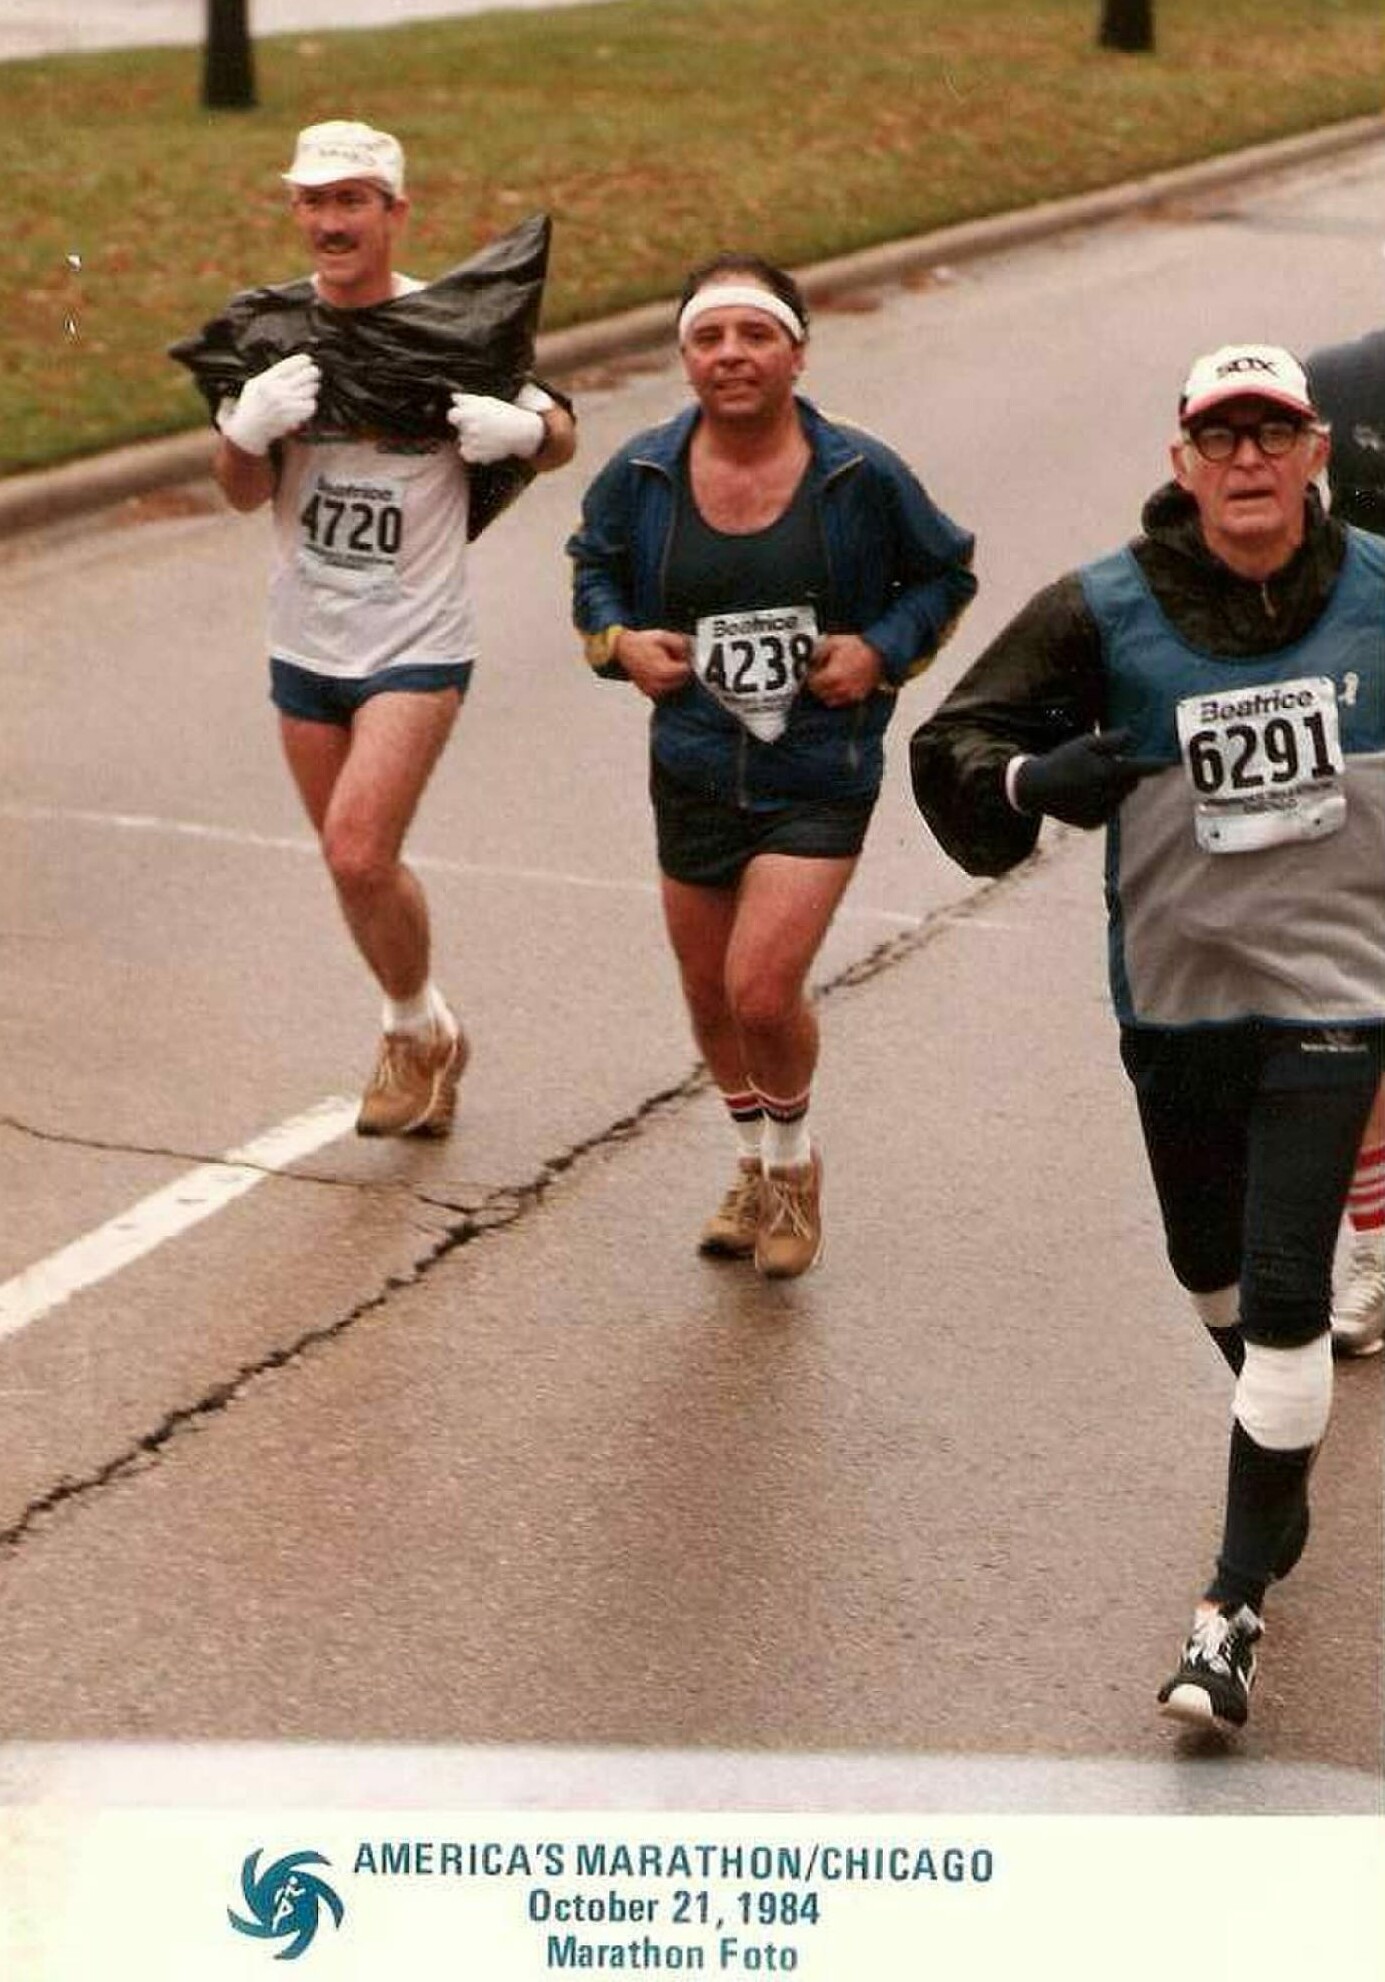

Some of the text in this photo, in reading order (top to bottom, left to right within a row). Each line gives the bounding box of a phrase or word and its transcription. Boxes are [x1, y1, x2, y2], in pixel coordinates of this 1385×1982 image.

[301, 492, 403, 554] 4720
[713, 615, 799, 638] Beatrice
[704, 633, 813, 692] 4238
[1200, 689, 1315, 723] Beatrice
[1188, 711, 1337, 793] 6291
